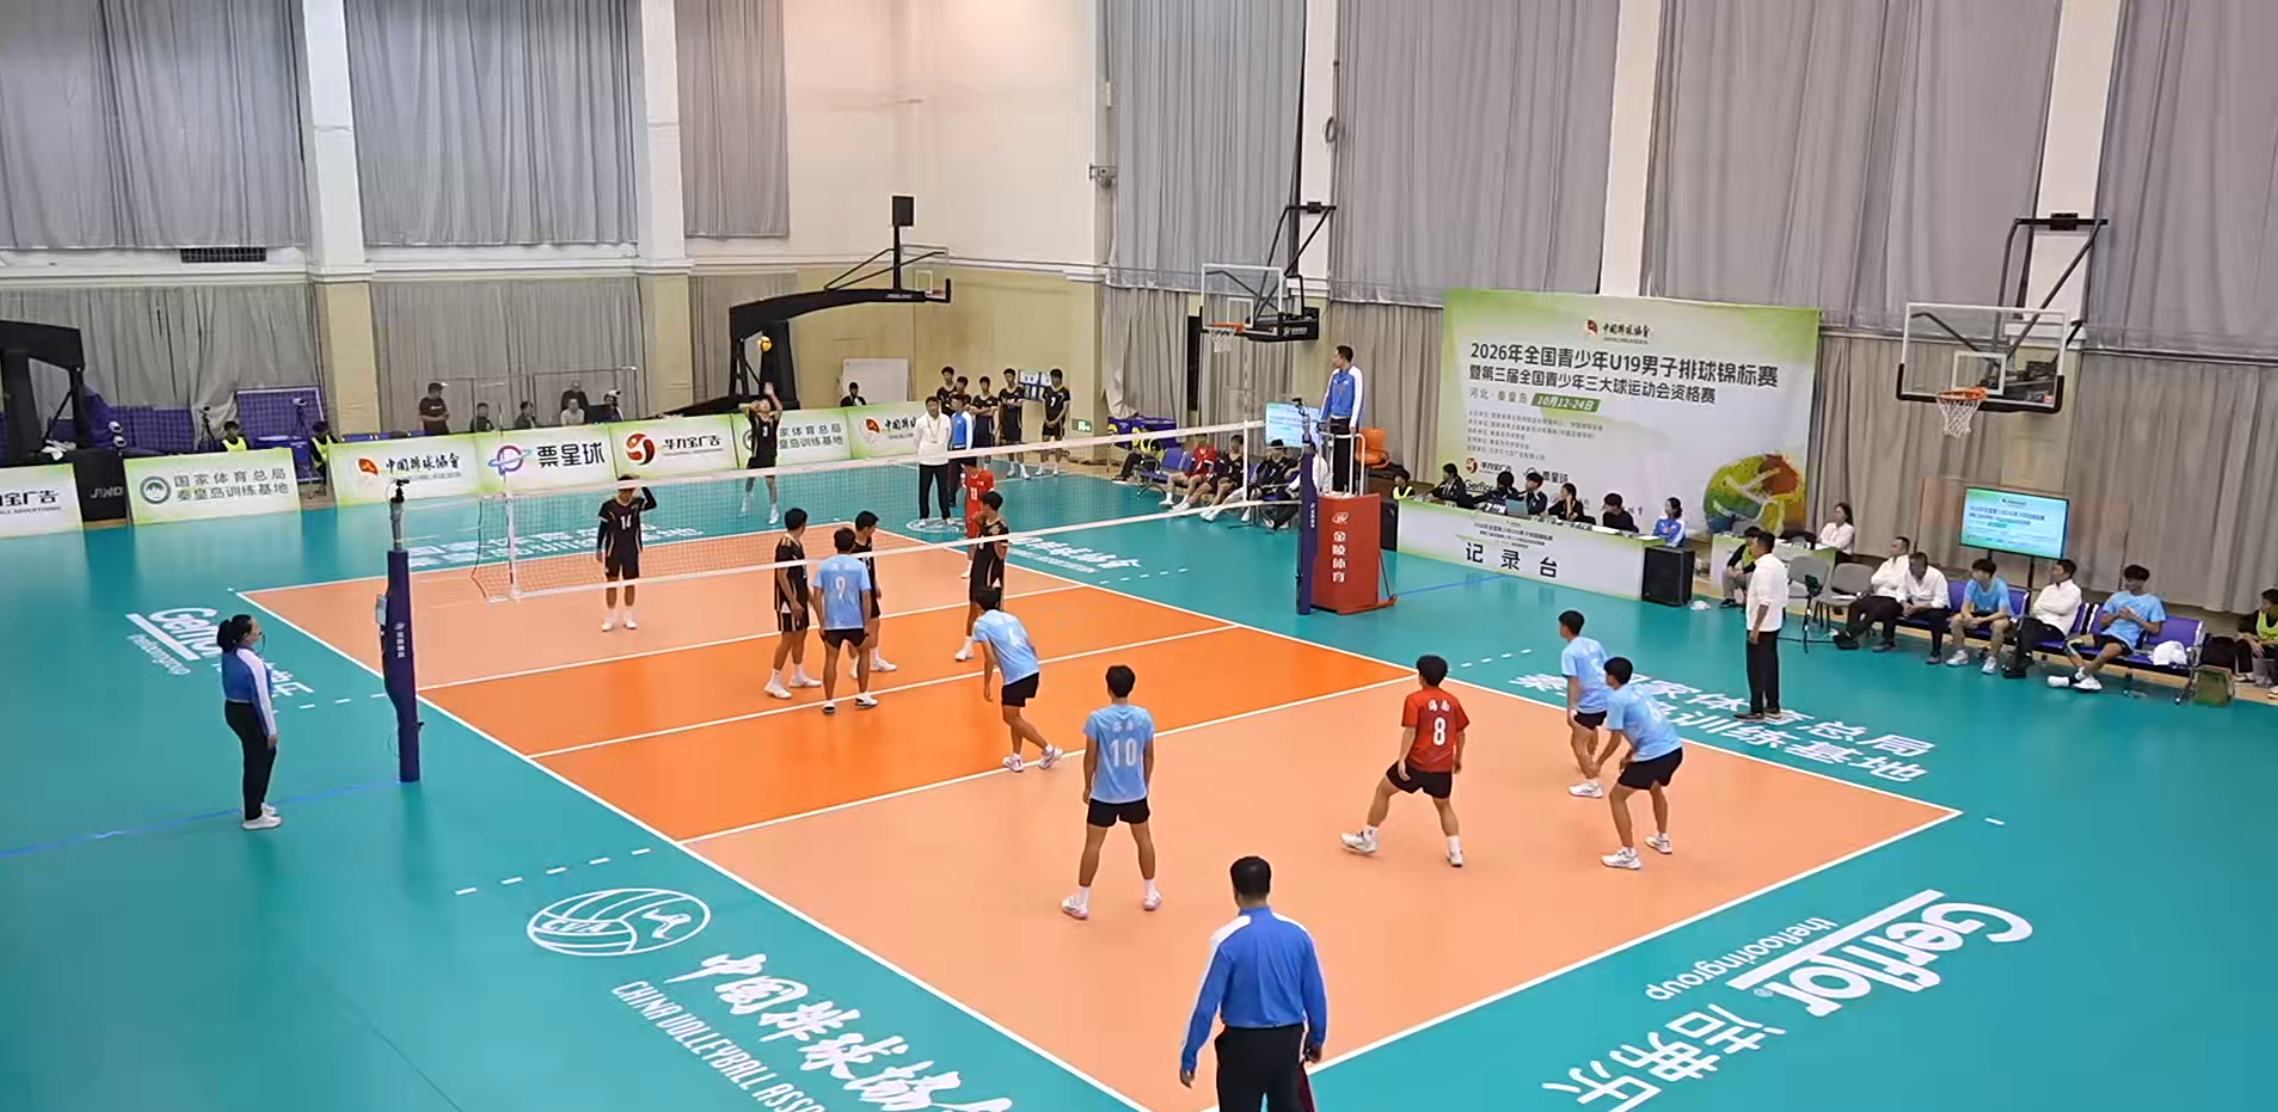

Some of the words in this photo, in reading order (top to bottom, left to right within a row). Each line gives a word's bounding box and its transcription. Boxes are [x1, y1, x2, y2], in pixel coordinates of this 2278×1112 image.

[1471, 343, 1779, 388] 2026年全国青少年U19男子排球锦标赛
[1470, 364, 1717, 405] 暨第三届全国青少年三大球运动会资格赛
[1537, 395, 1594, 410] 10月12-24日
[779, 423, 842, 437] 家体育总局
[779, 435, 843, 449] 皇岛训练基地
[537, 442, 605, 468] 票星球
[174, 468, 286, 487] 国家体育总局
[177, 483, 290, 501] 秦皇岛训练基地
[1465, 542, 1558, 578] 记录台
[835, 576, 846, 600] 9
[1433, 717, 1446, 746] 8
[1110, 738, 1137, 767] 10
[1768, 902, 2033, 1016] Gerflor
[612, 980, 683, 1020] CHINA
[1542, 1004, 1786, 1112] 洁弗乐
